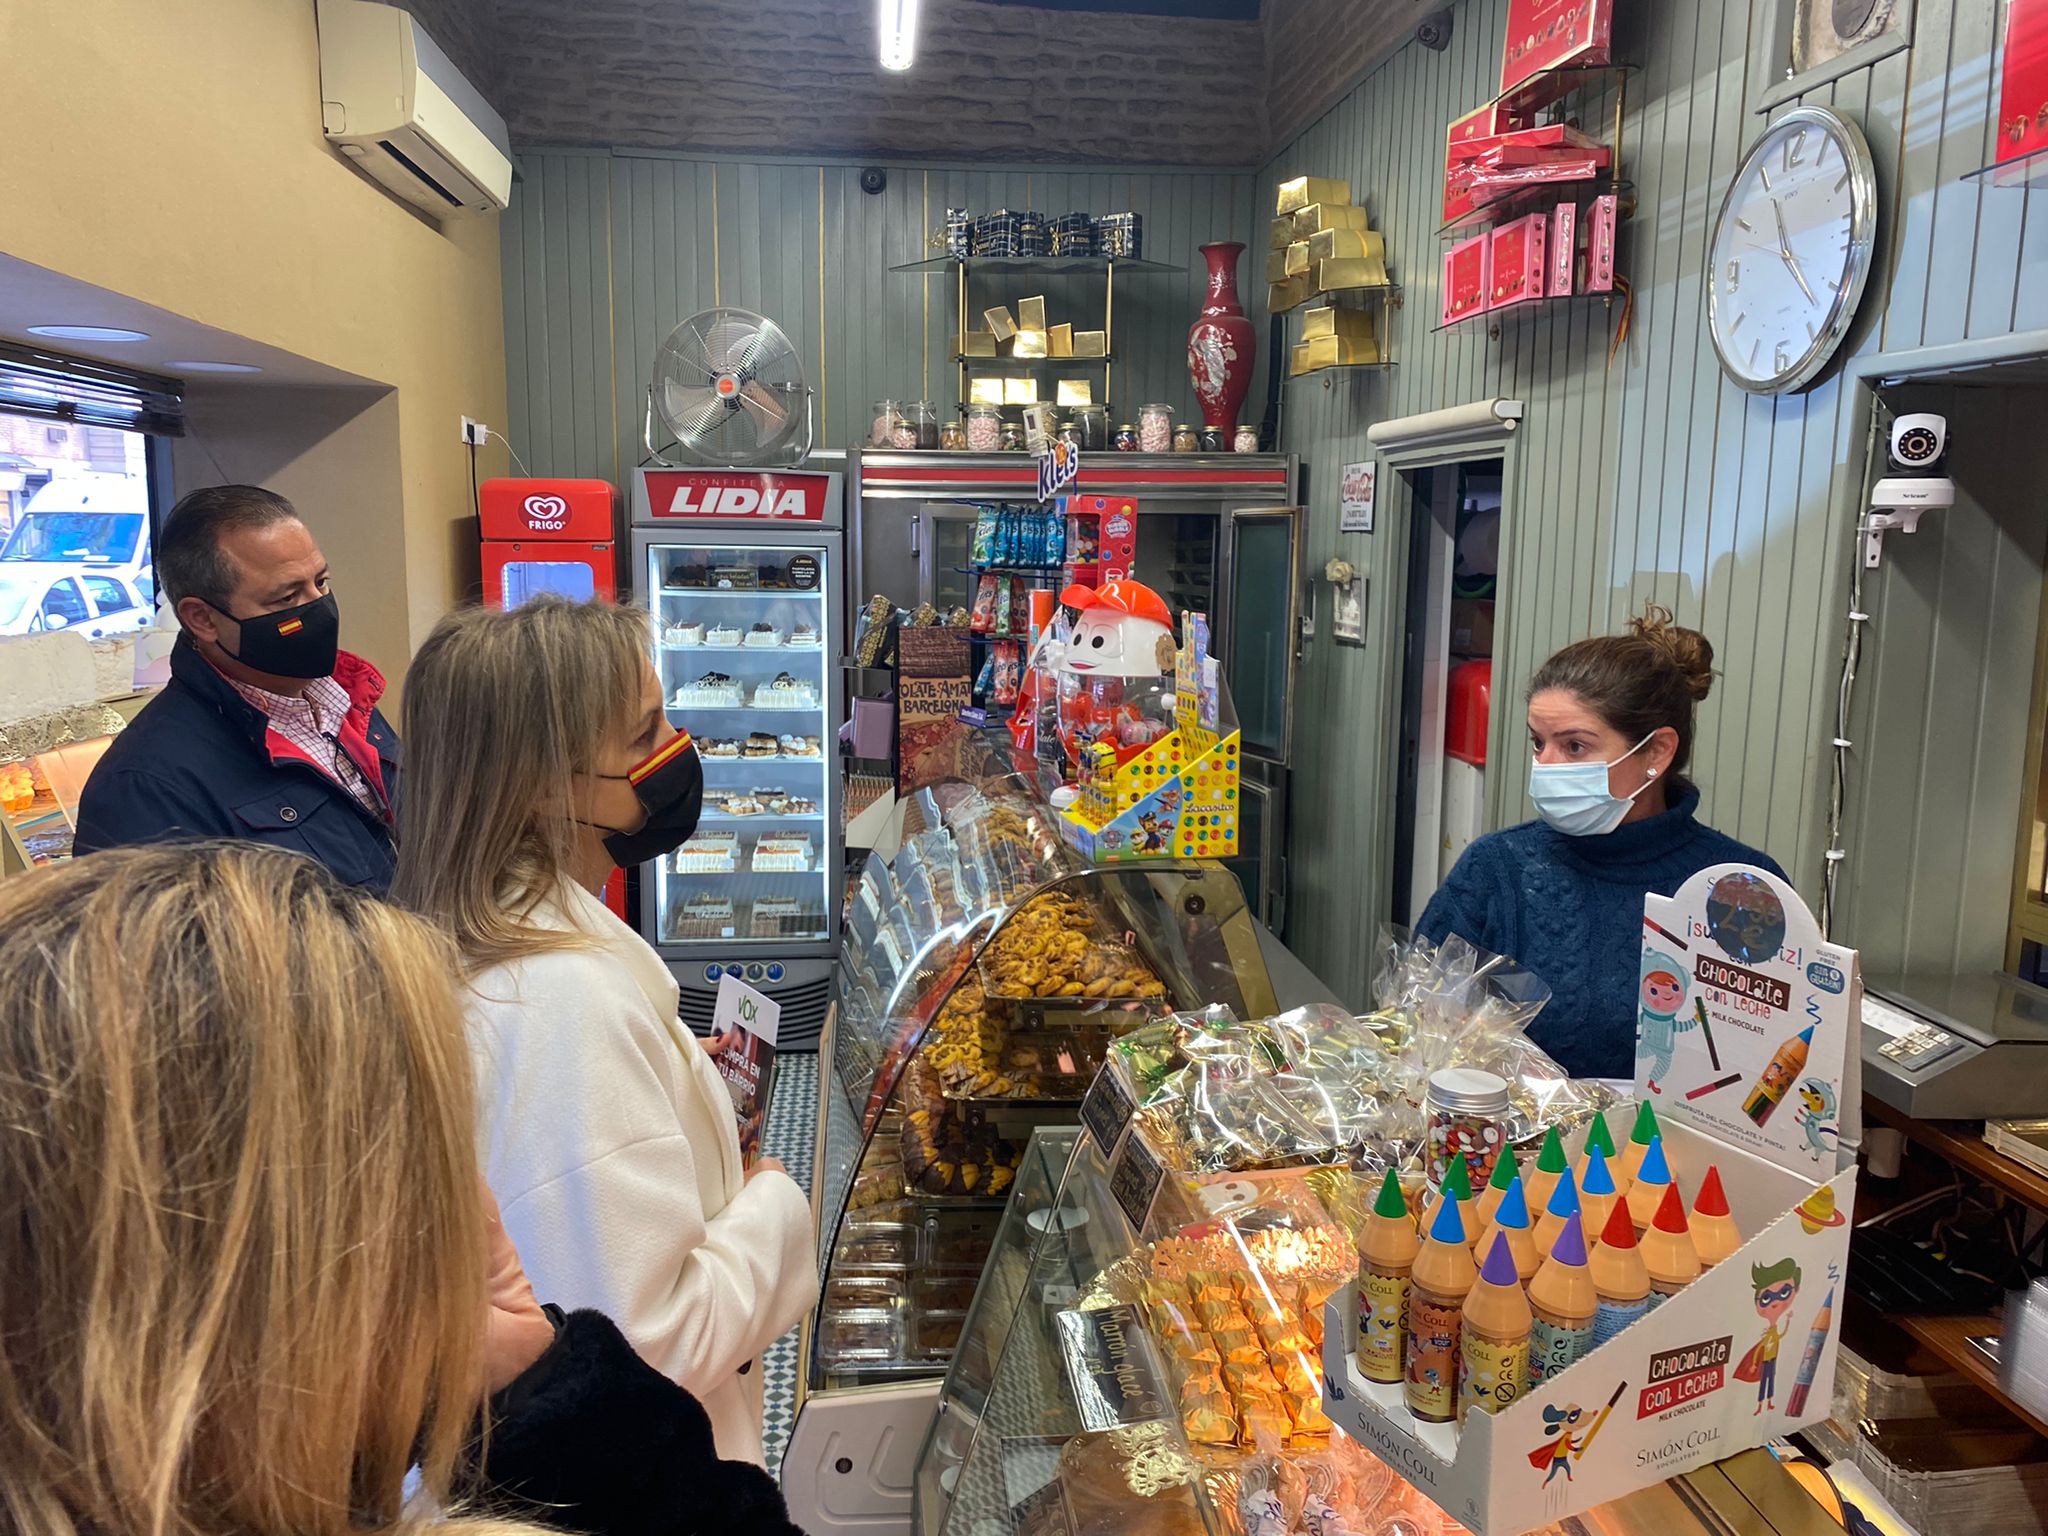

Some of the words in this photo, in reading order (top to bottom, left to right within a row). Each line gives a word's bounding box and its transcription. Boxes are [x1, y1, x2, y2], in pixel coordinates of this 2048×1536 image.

[688, 477, 785, 488] CONFITEA
[669, 486, 807, 516] LIDIA
[528, 520, 563, 530] FRIGO
[1185, 804, 1234, 813] Lacasitos
[1699, 960, 1784, 1006] CHOCOLate
[738, 995, 758, 1024] VOX
[1733, 996, 1771, 1020] LeCHe
[1711, 1011, 1727, 1022] MILK
[1727, 1016, 1765, 1036] CHOCOLATE
[728, 1069, 756, 1097] BARRIO
[749, 1063, 761, 1080] EN
[1705, 1113, 1718, 1123] DEL
[1370, 1281, 1393, 1295] COLL
[1423, 1312, 1448, 1327] COLL
[1096, 1309, 1137, 1360] Marrón
[1467, 1343, 1491, 1361] COLL
[1652, 1340, 1727, 1380] CHOCOLate
[1677, 1370, 1719, 1400] LeCHe
[1658, 1411, 1674, 1422] MILK
[1673, 1399, 1707, 1419] CHOCOLATE
[1357, 1411, 1400, 1457] SIMÓN
[1402, 1448, 1438, 1487] COLL
[1636, 1438, 1683, 1468] SIMÓN
[1686, 1427, 1721, 1450] COLL
